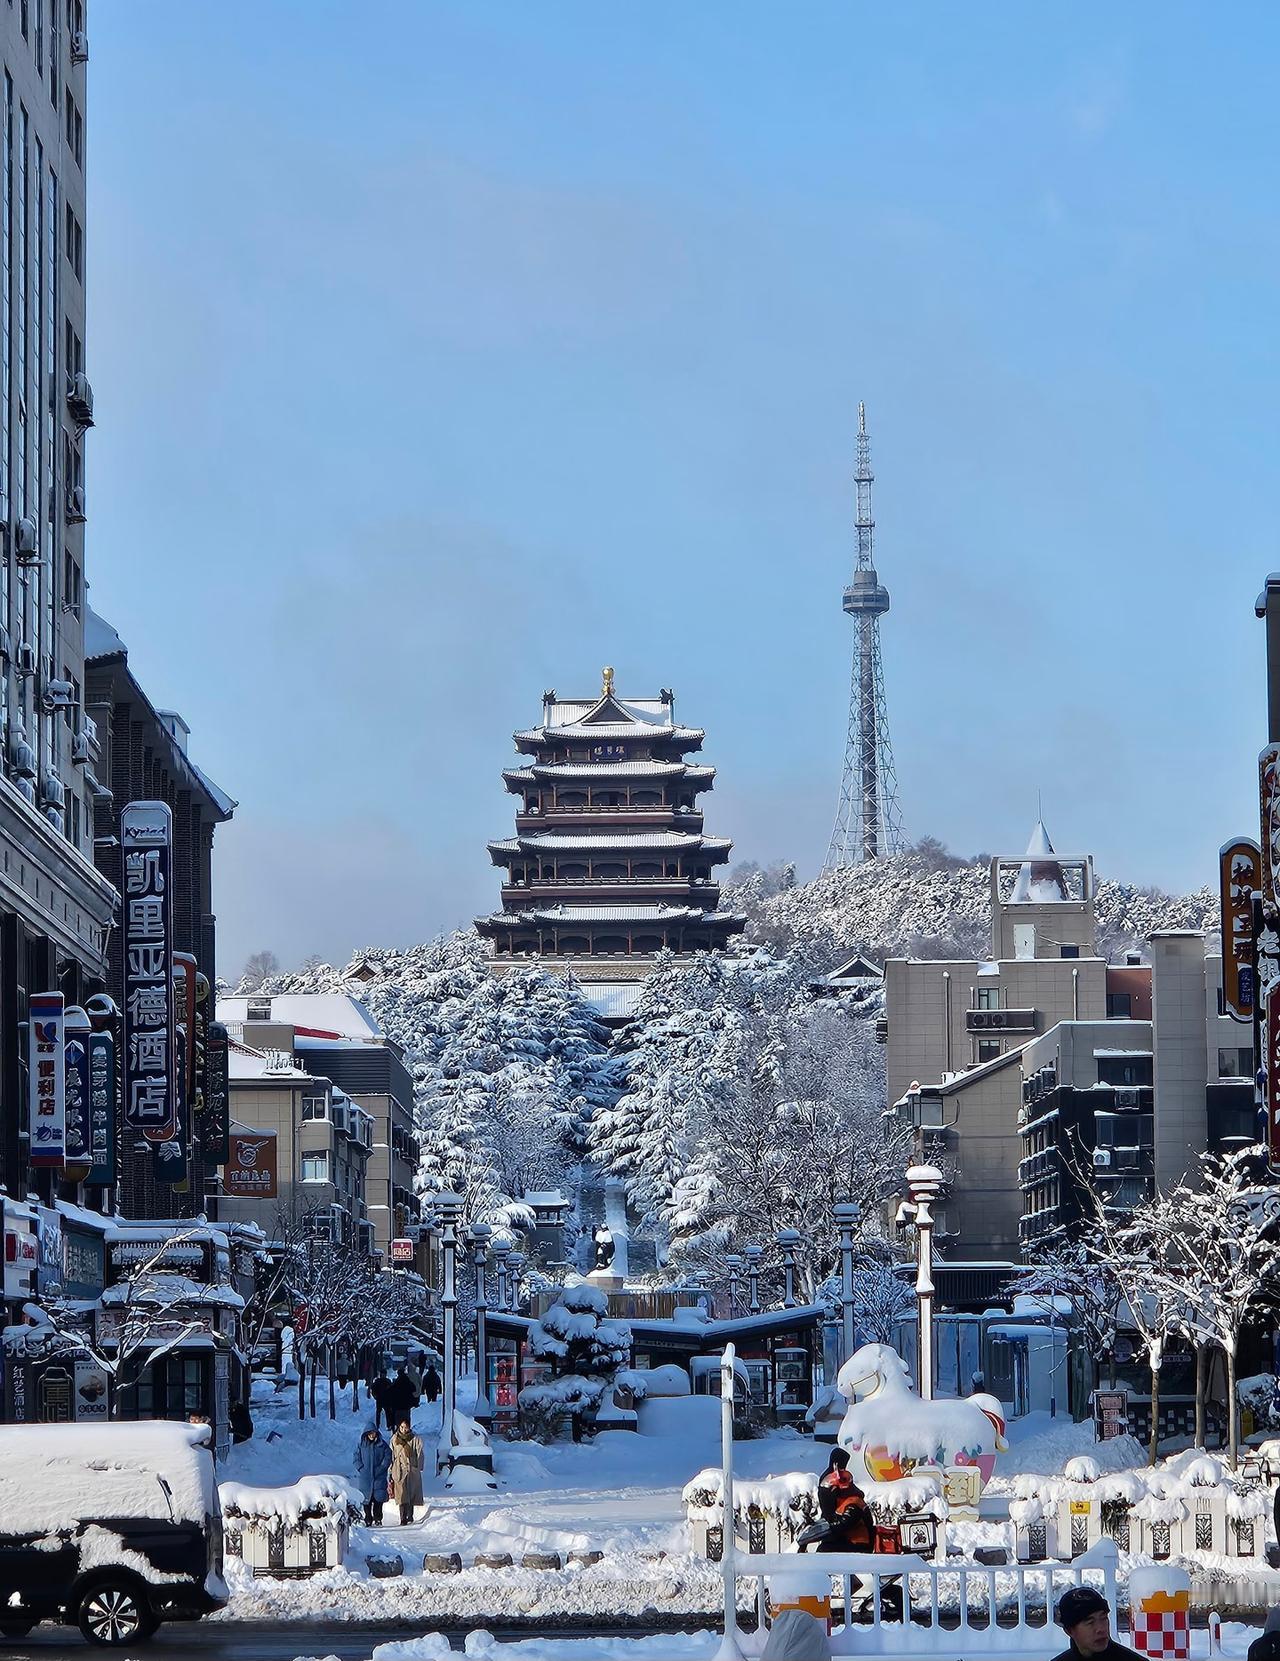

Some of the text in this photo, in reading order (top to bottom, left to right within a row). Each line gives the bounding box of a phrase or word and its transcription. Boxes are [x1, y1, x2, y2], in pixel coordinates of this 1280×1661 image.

[125, 850, 167, 1117] 凯里亚德酒店
[37, 1059, 56, 1116] 便利店
